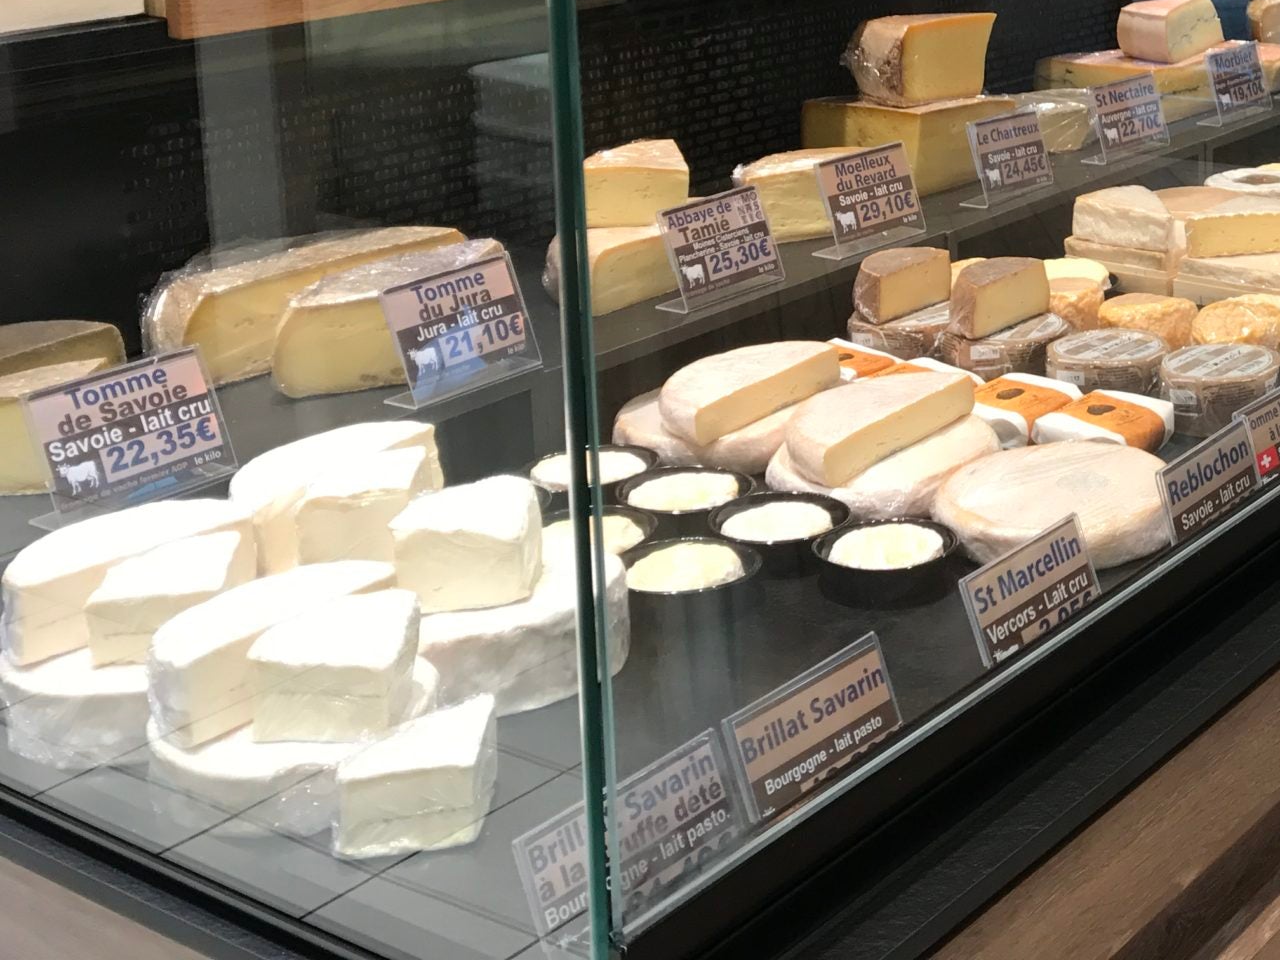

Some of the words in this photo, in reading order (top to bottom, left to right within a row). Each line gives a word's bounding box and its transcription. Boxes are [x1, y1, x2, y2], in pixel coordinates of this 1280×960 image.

[1215, 51, 1253, 71] Morbier
[1095, 93, 1108, 108] St
[1108, 83, 1155, 104] Nectaire
[976, 132, 989, 146] Le
[990, 123, 1040, 142] Chartreux
[1121, 114, 1162, 137] 22,70€
[835, 155, 891, 178] Moelleux
[988, 150, 1011, 164] Savoie
[1015, 147, 1026, 158] lait
[1026, 145, 1037, 154] cru
[1004, 155, 1046, 179] 24,45€
[837, 178, 853, 192] du
[855, 165, 897, 188] Revard
[839, 190, 869, 206] Savoie
[874, 185, 888, 197] lait
[890, 181, 904, 192] cru
[667, 206, 714, 230] Abbaye
[716, 201, 732, 213] de
[860, 192, 915, 222] 29,10€
[678, 215, 731, 242] Tamié
[692, 238, 714, 250] Moines
[709, 239, 771, 275] 25,30€
[410, 272, 485, 305] Tomme
[418, 301, 444, 322] du
[449, 289, 492, 312] Jura
[417, 323, 448, 341] Jura
[457, 311, 479, 328] lait
[481, 304, 503, 320] cru
[445, 314, 523, 358] 21,10€
[64, 368, 168, 411] Tomme
[57, 413, 92, 437] de
[98, 384, 188, 423] Savoie
[1249, 407, 1279, 430] omme
[49, 426, 123, 462] Savoie
[139, 407, 174, 433] lait
[178, 398, 211, 421] cru
[106, 416, 217, 474] 22,35€
[1269, 427, 1276, 441] à
[194, 454, 204, 466] le
[204, 450, 221, 464] kilo
[1168, 440, 1249, 506] Reblochon
[1181, 498, 1214, 530] Savoie
[1220, 484, 1235, 504] lait
[1235, 474, 1250, 493] cru
[974, 584, 997, 615] St
[997, 537, 1081, 600] Marcellin
[986, 606, 1037, 644] Vercors
[1043, 583, 1068, 609] Lait
[1069, 572, 1088, 593] cru
[740, 709, 809, 765] Brillat
[810, 668, 884, 724] Savarin
[764, 749, 828, 795] Bourgogne
[834, 733, 853, 751] lait
[854, 716, 882, 744] pasto
[624, 753, 714, 821] Savarin
[541, 877, 556, 902] à
[560, 860, 586, 888] la
[615, 814, 669, 859] ruffe
[659, 835, 685, 860] lait
